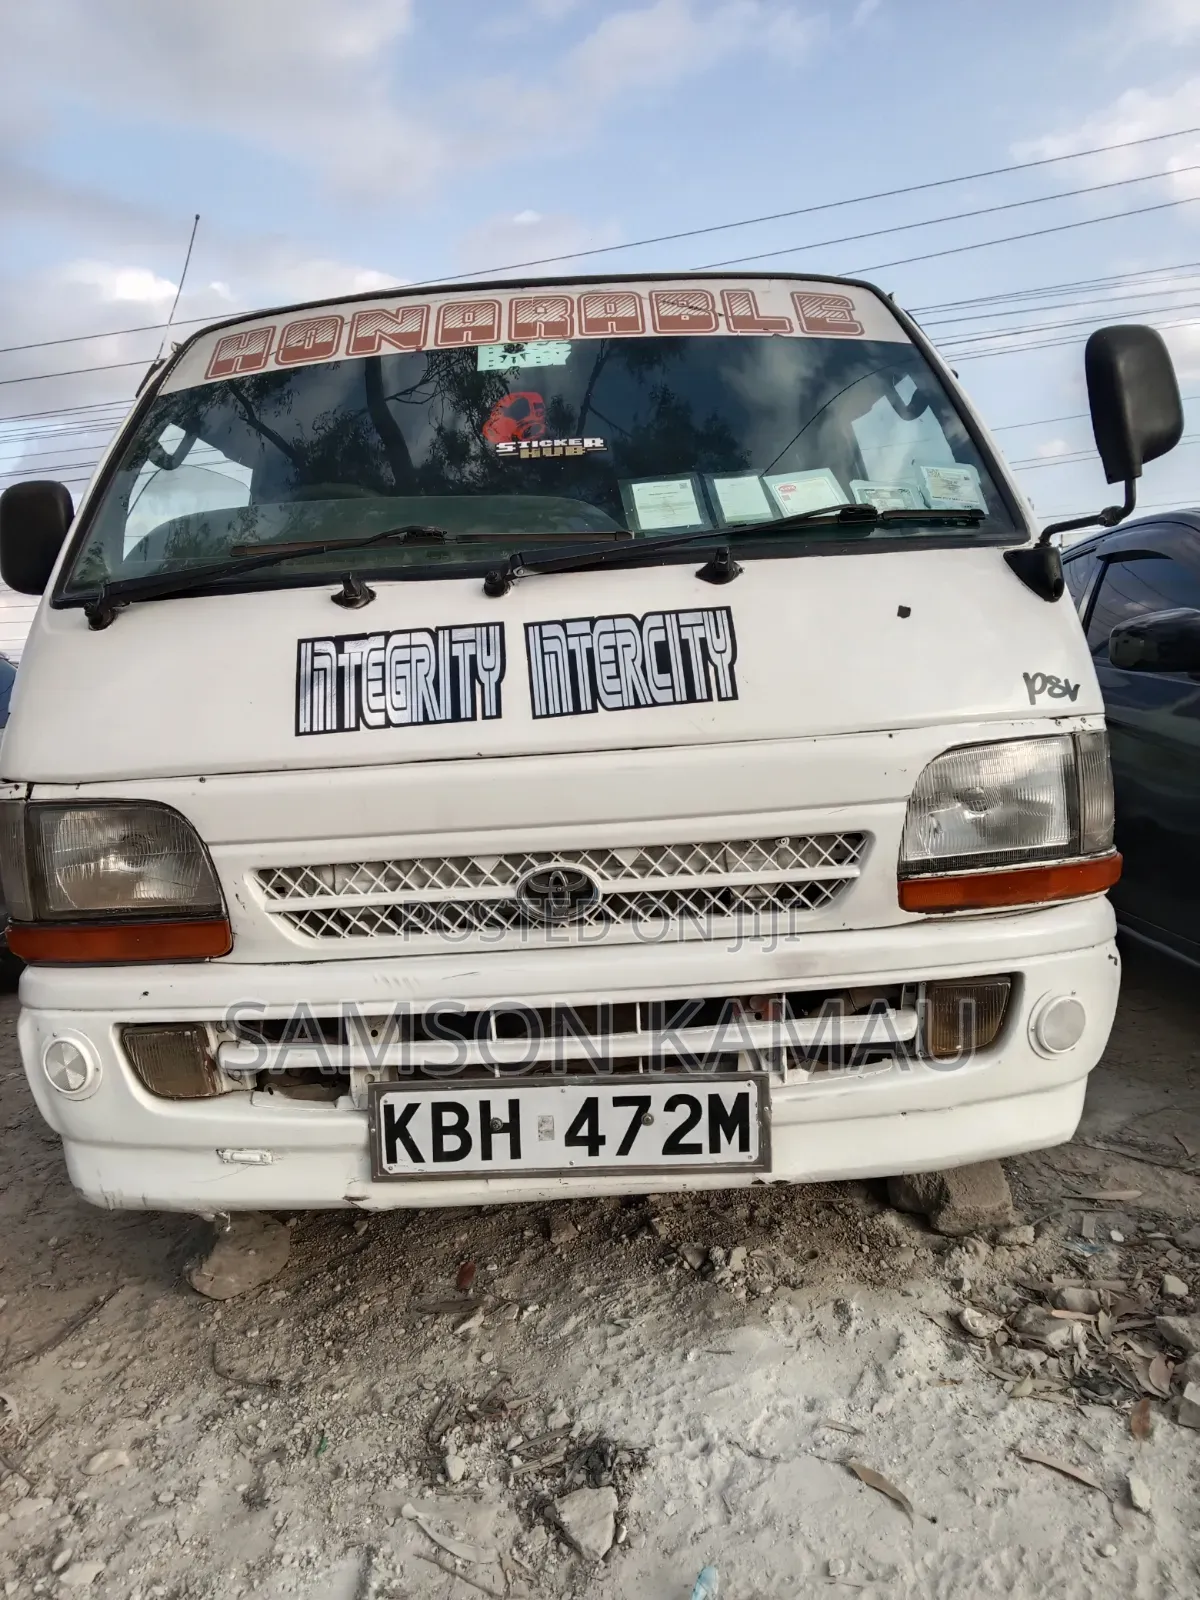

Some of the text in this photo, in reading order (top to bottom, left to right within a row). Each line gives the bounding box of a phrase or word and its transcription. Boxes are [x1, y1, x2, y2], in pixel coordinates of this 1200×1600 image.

[204, 289, 864, 379] HONARABLE
[496, 438, 604, 452] STICKER
[520, 446, 586, 459] HUB
[296, 606, 738, 736] INTEGRITY INTERCITY
[383, 1092, 750, 1164] KBH 472M
